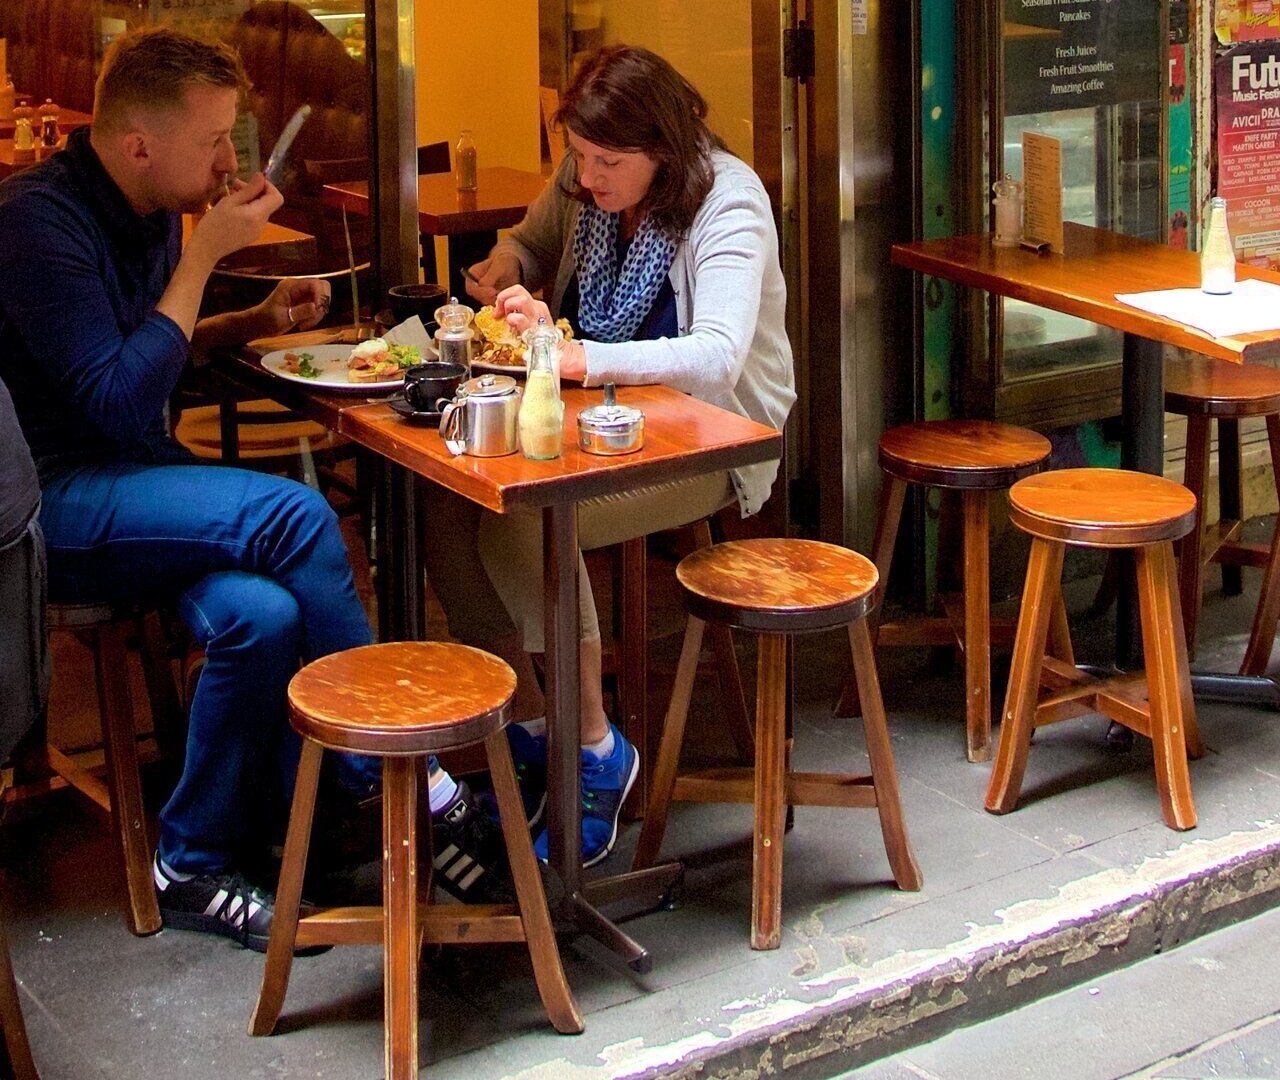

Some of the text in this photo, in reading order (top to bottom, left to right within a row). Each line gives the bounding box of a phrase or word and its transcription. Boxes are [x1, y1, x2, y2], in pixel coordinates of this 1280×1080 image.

[1060, 10, 1091, 22] Pancakes
[1056, 46, 1097, 58] Fresh Juices
[1040, 61, 1114, 78] Fresh Fruit Smoothies
[1051, 80, 1104, 95] Amazing Coffee
[1233, 90, 1258, 102] Music
